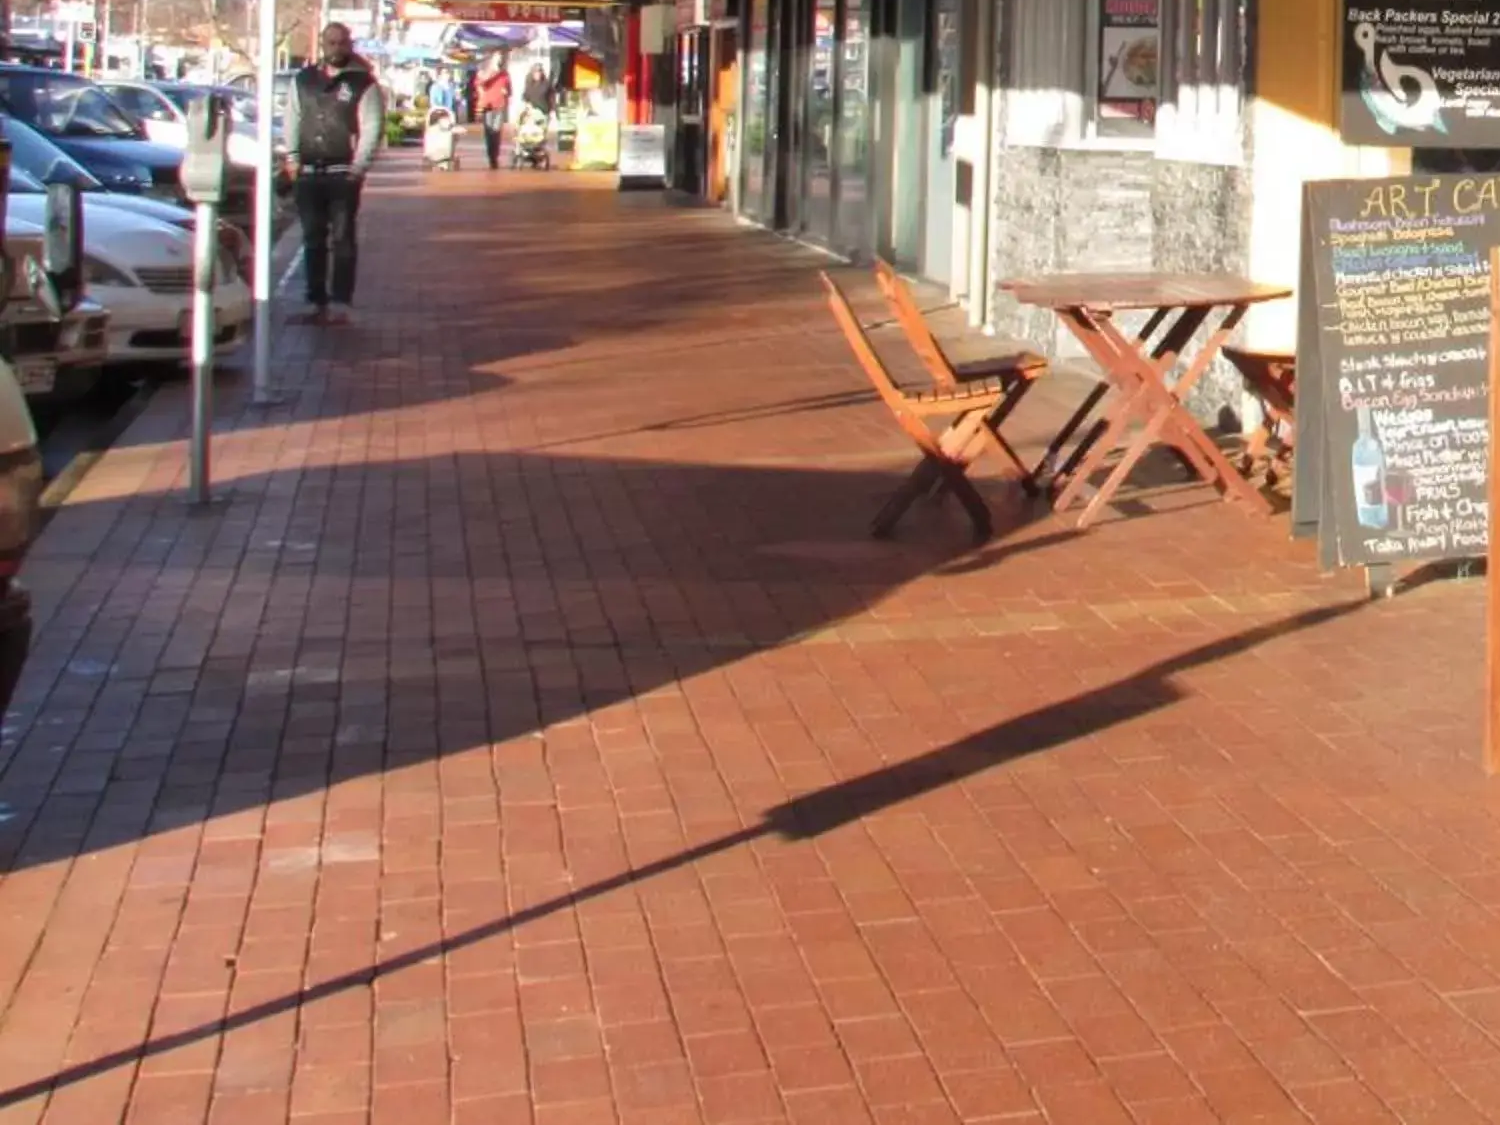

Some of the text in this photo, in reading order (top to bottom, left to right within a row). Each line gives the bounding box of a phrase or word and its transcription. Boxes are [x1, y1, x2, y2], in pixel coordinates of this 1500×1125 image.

[1348, 7, 1384, 22] Back
[1386, 8, 1438, 23] Packers
[1441, 10, 1489, 25] Special
[1492, 11, 1500, 24] 2
[1431, 66, 1500, 83] Vegetarian
[1360, 178, 1441, 218] ART
